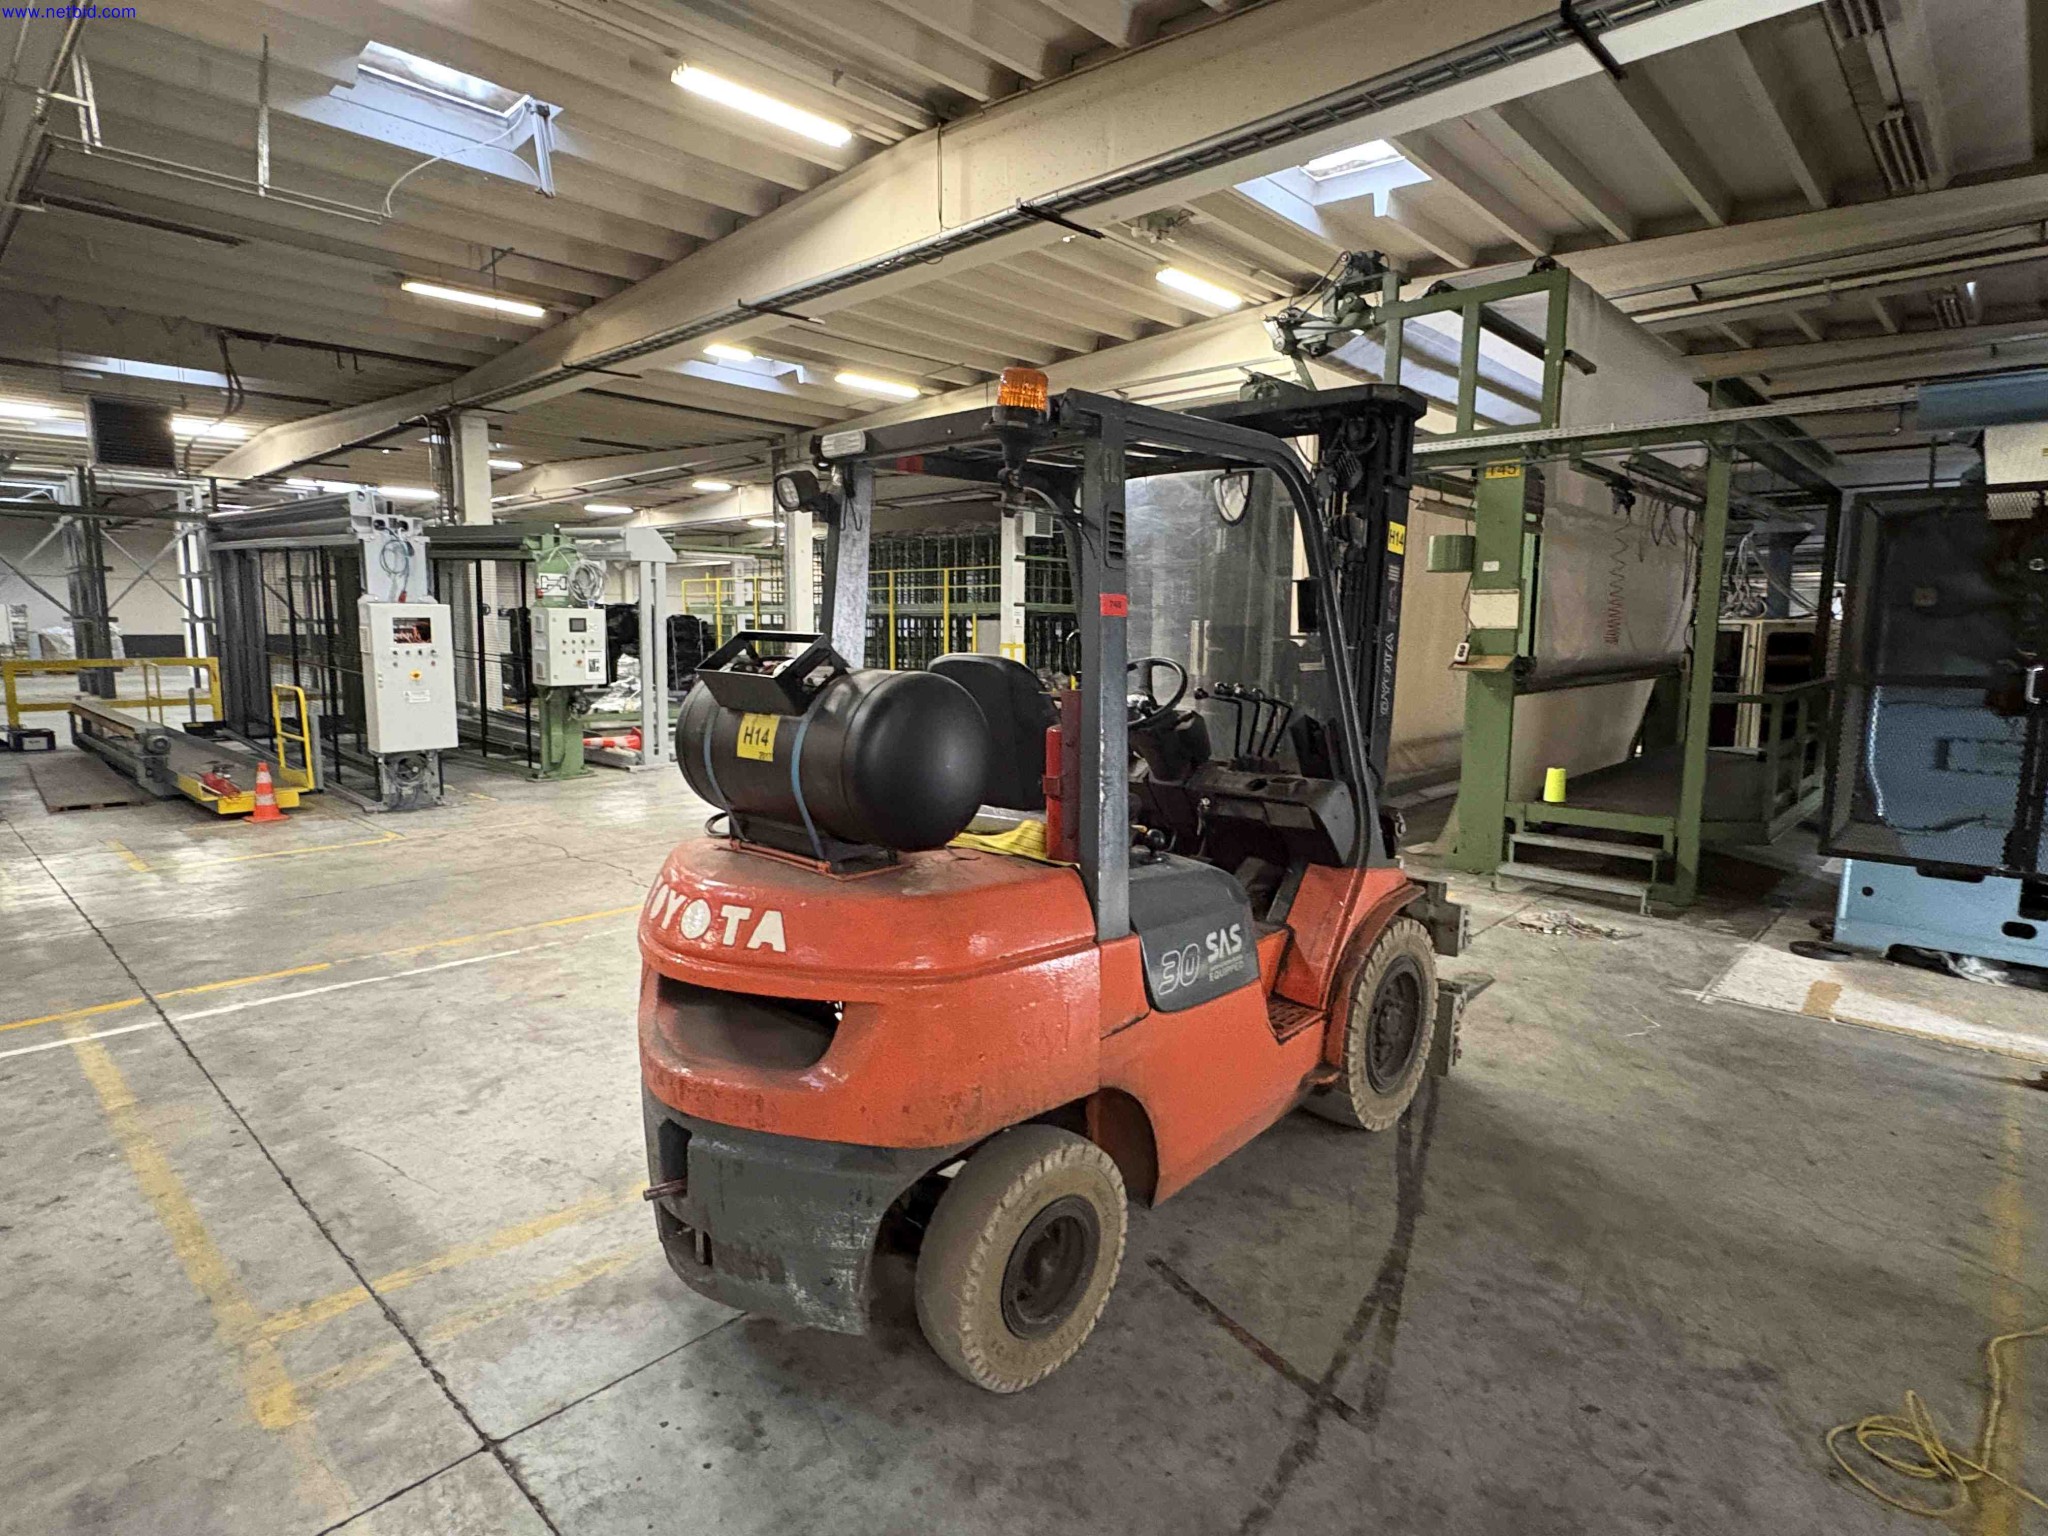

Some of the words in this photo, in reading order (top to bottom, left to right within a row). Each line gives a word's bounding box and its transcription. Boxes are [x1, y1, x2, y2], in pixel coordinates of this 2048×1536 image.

[1389, 529, 1404, 546] H14
[743, 726, 770, 746] H14
[1158, 943, 1200, 995] 30
[1205, 923, 1243, 963] SAS
